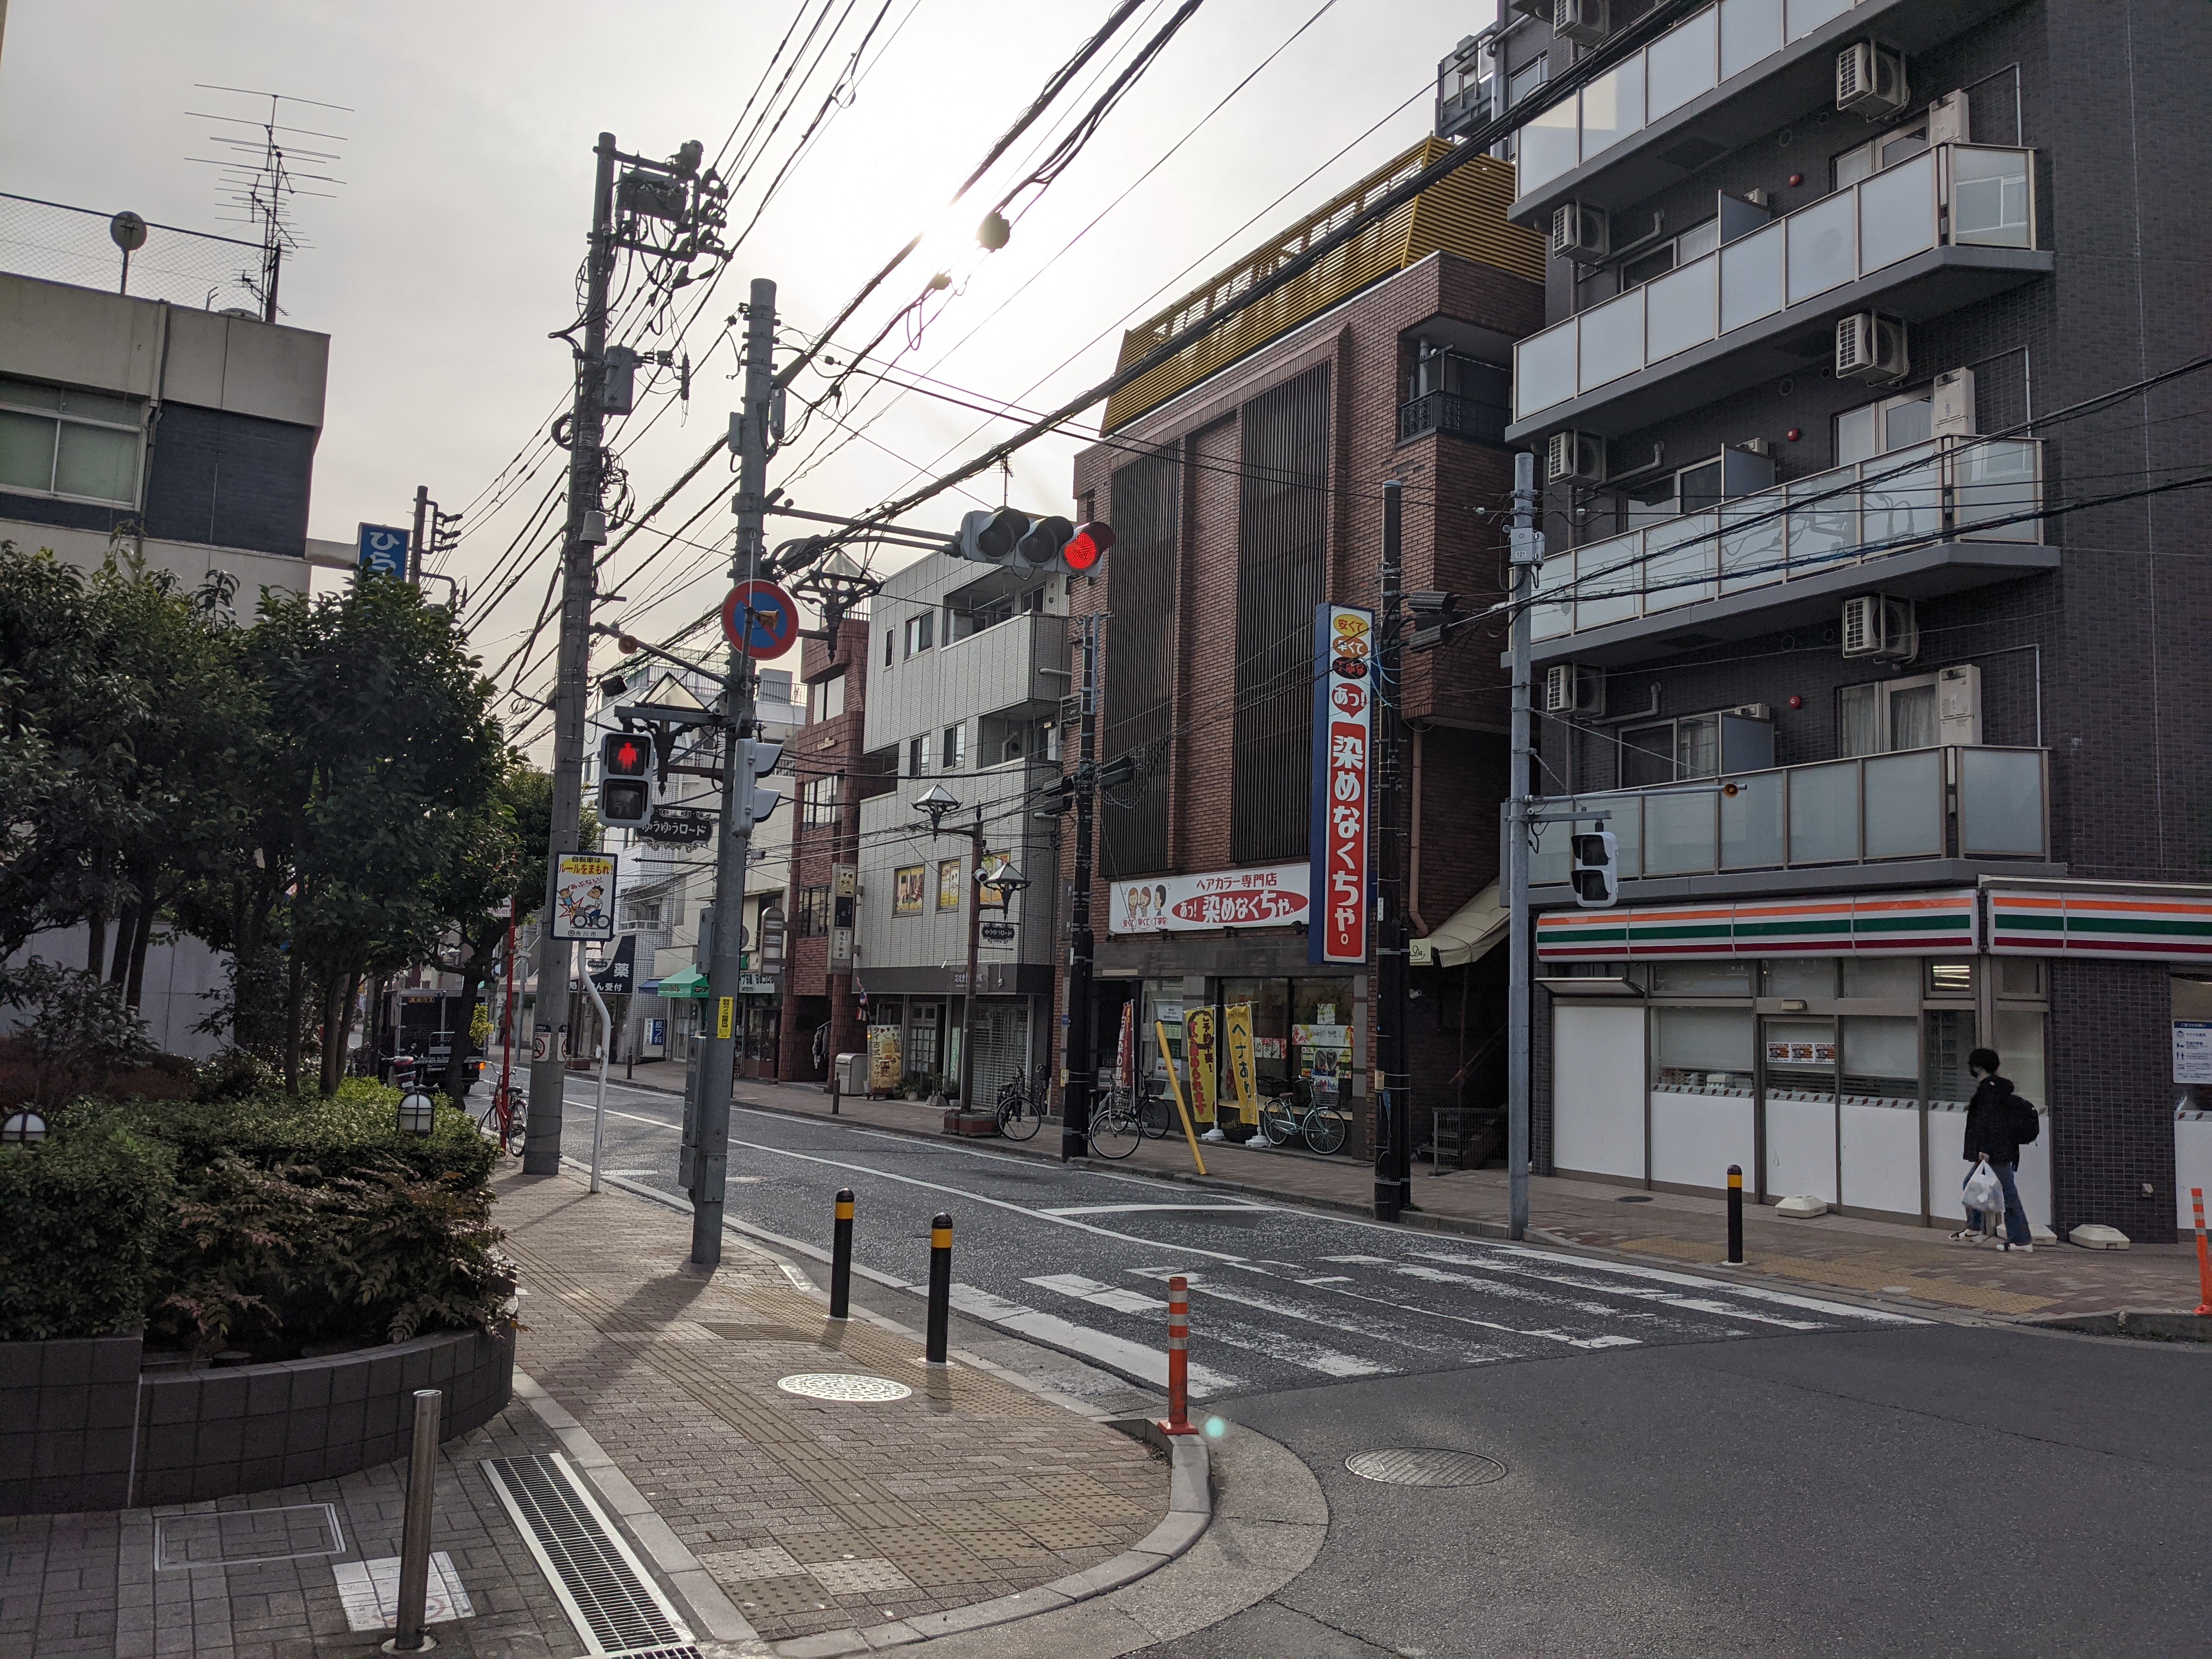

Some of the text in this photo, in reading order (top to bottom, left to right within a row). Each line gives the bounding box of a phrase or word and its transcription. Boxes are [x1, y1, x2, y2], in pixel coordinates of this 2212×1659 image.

[1338, 619, 1364, 632] 安くて
[1337, 640, 1364, 655] 早くて
[1332, 735, 1363, 945] 染めなくちゃ。
[558, 864, 613, 875] ルールをまもれ!
[1197, 872, 1277, 891] ヘアカラー専門店
[1202, 889, 1294, 923] 染めなくちゃ。
[613, 962, 630, 978] 薬
[569, 981, 623, 992] 処ん受付
[654, 1020, 663, 1045] 皮フ科
[1232, 1023, 1251, 1099] ヘナあり
